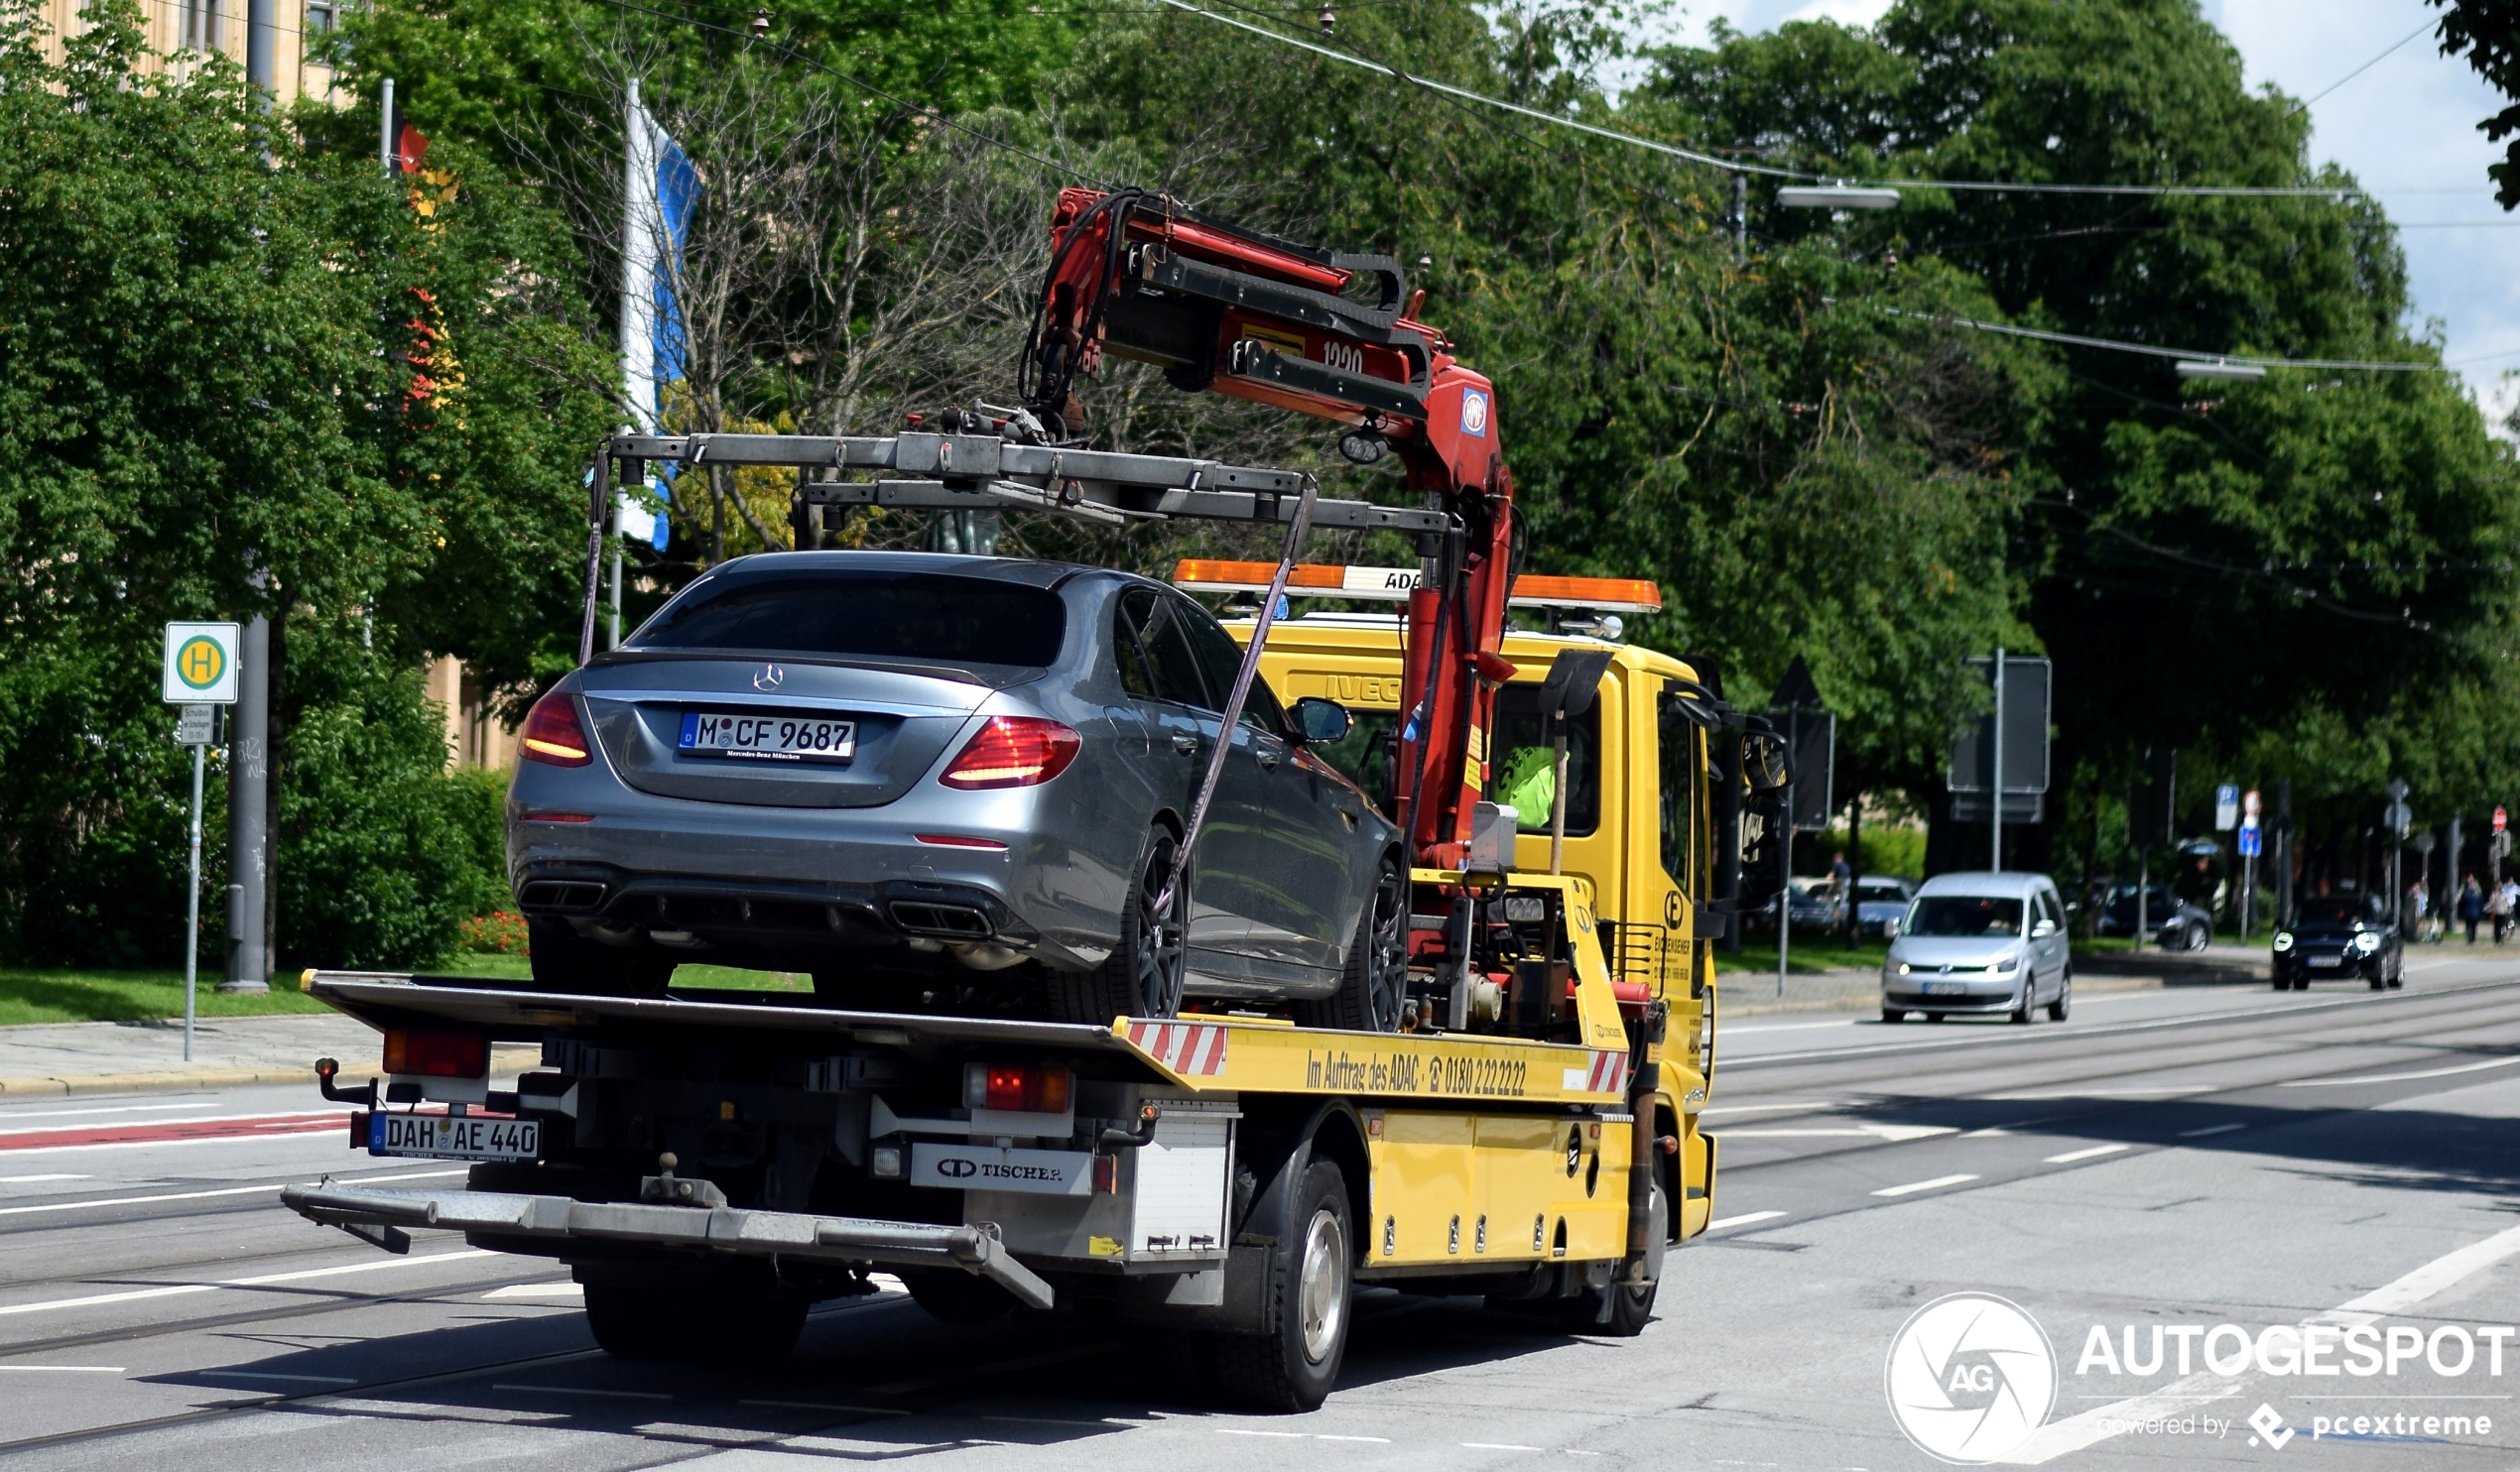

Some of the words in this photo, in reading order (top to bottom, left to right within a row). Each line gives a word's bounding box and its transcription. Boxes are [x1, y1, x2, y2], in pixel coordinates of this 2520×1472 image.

[1466, 398, 1483, 429] HMF
[1384, 572, 1421, 589] ADA
[189, 647, 213, 678] H
[1324, 675, 1402, 703] IVEC
[185, 708, 209, 717] Schulbus
[697, 717, 719, 745] M
[735, 719, 774, 747] CF
[779, 721, 851, 752] 9687
[726, 750, 771, 759] Mercedes-Benz
[1508, 751, 1524, 768] des
[1306, 1048, 1322, 1088] Im
[1323, 1049, 1366, 1093] Auftrag
[1369, 1052, 1387, 1090] des
[1389, 1053, 1420, 1092] ADAC
[1445, 1056, 1473, 1094] 0180
[374, 1135, 381, 1144] D
[387, 1119, 435, 1149] DAH
[453, 1122, 485, 1152] AE
[490, 1124, 536, 1154] 440
[981, 1164, 1064, 1182] TISCHER
